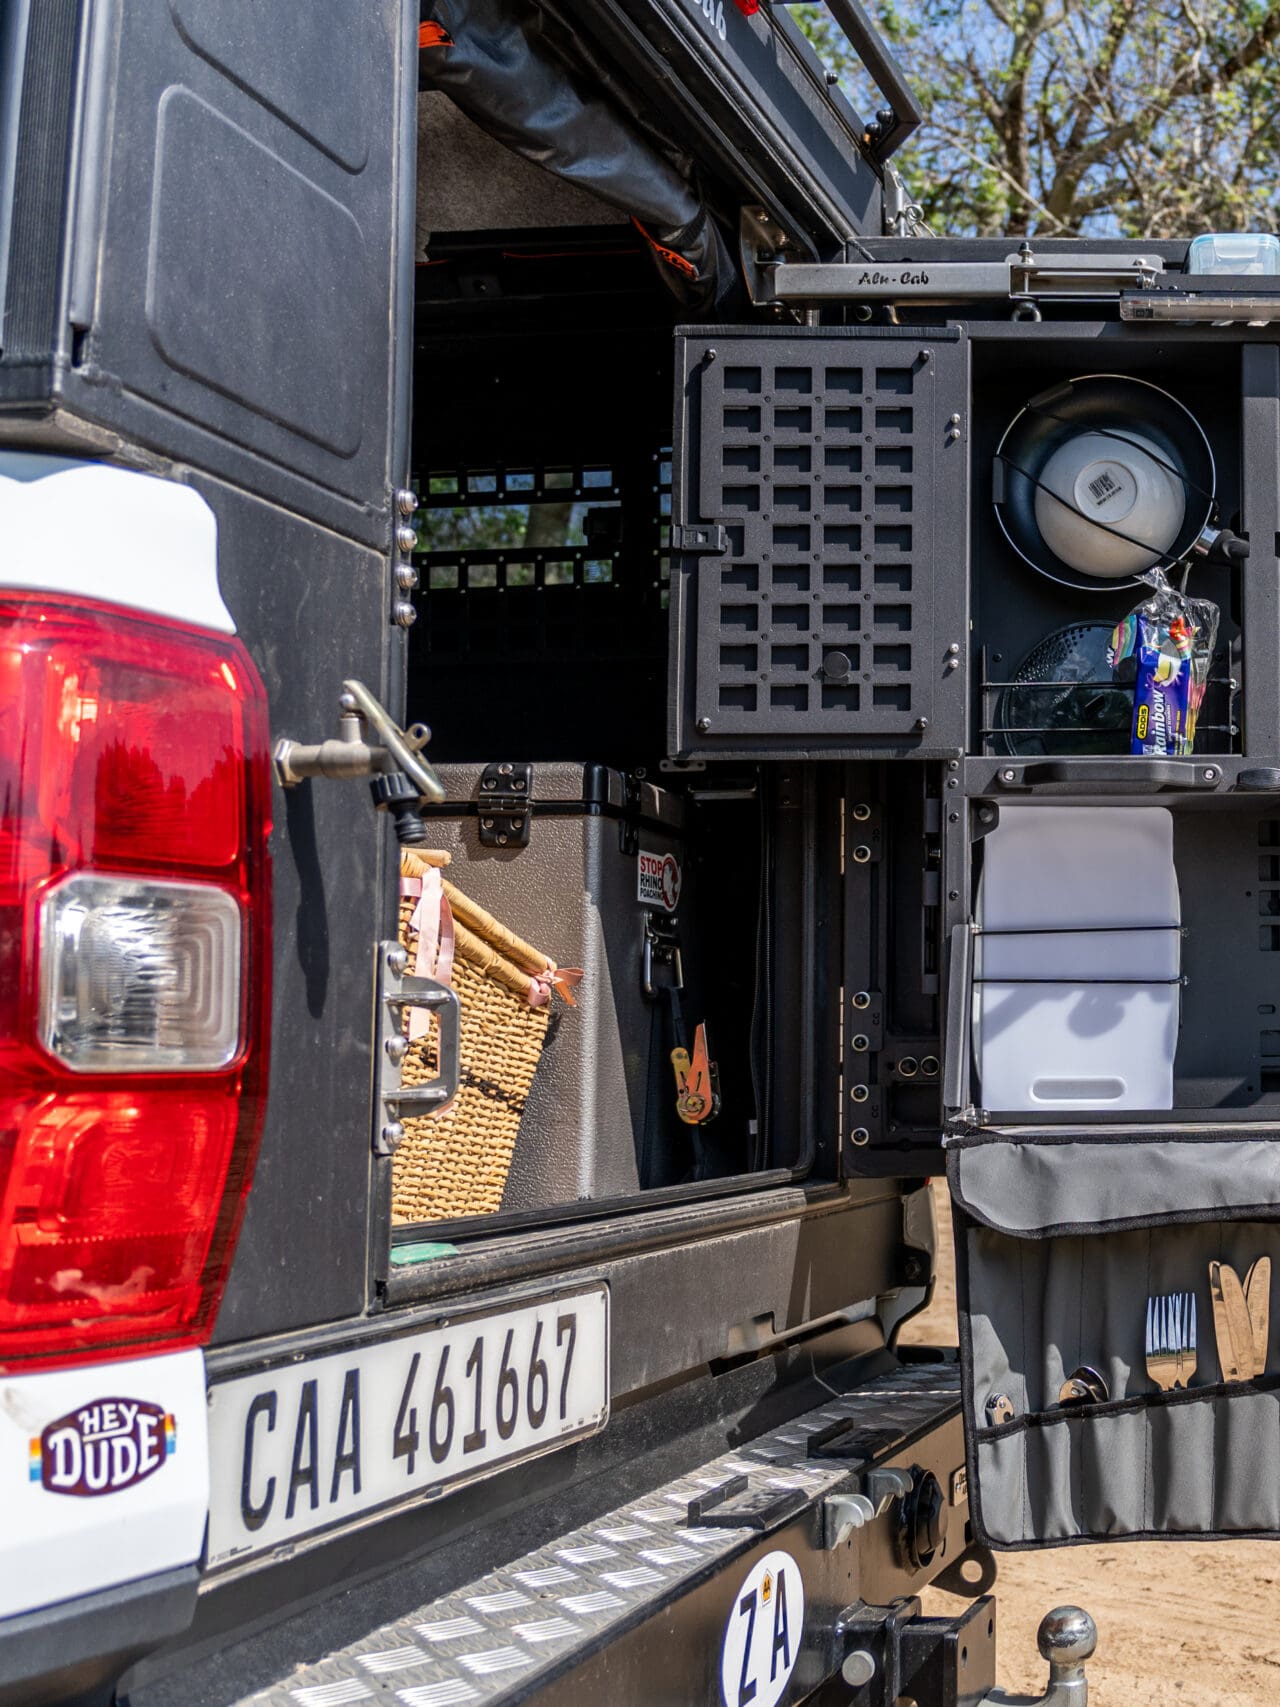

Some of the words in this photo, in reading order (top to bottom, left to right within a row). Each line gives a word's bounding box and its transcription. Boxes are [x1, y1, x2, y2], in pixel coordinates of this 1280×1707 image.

[1151, 688, 1167, 756] Rainbow
[640, 855, 664, 876] STOP
[640, 873, 664, 891] RHINO
[78, 1403, 139, 1437] HEY
[240, 1367, 362, 1532] CAA
[392, 1311, 578, 1476] 461667
[48, 1413, 160, 1490] DUDE
